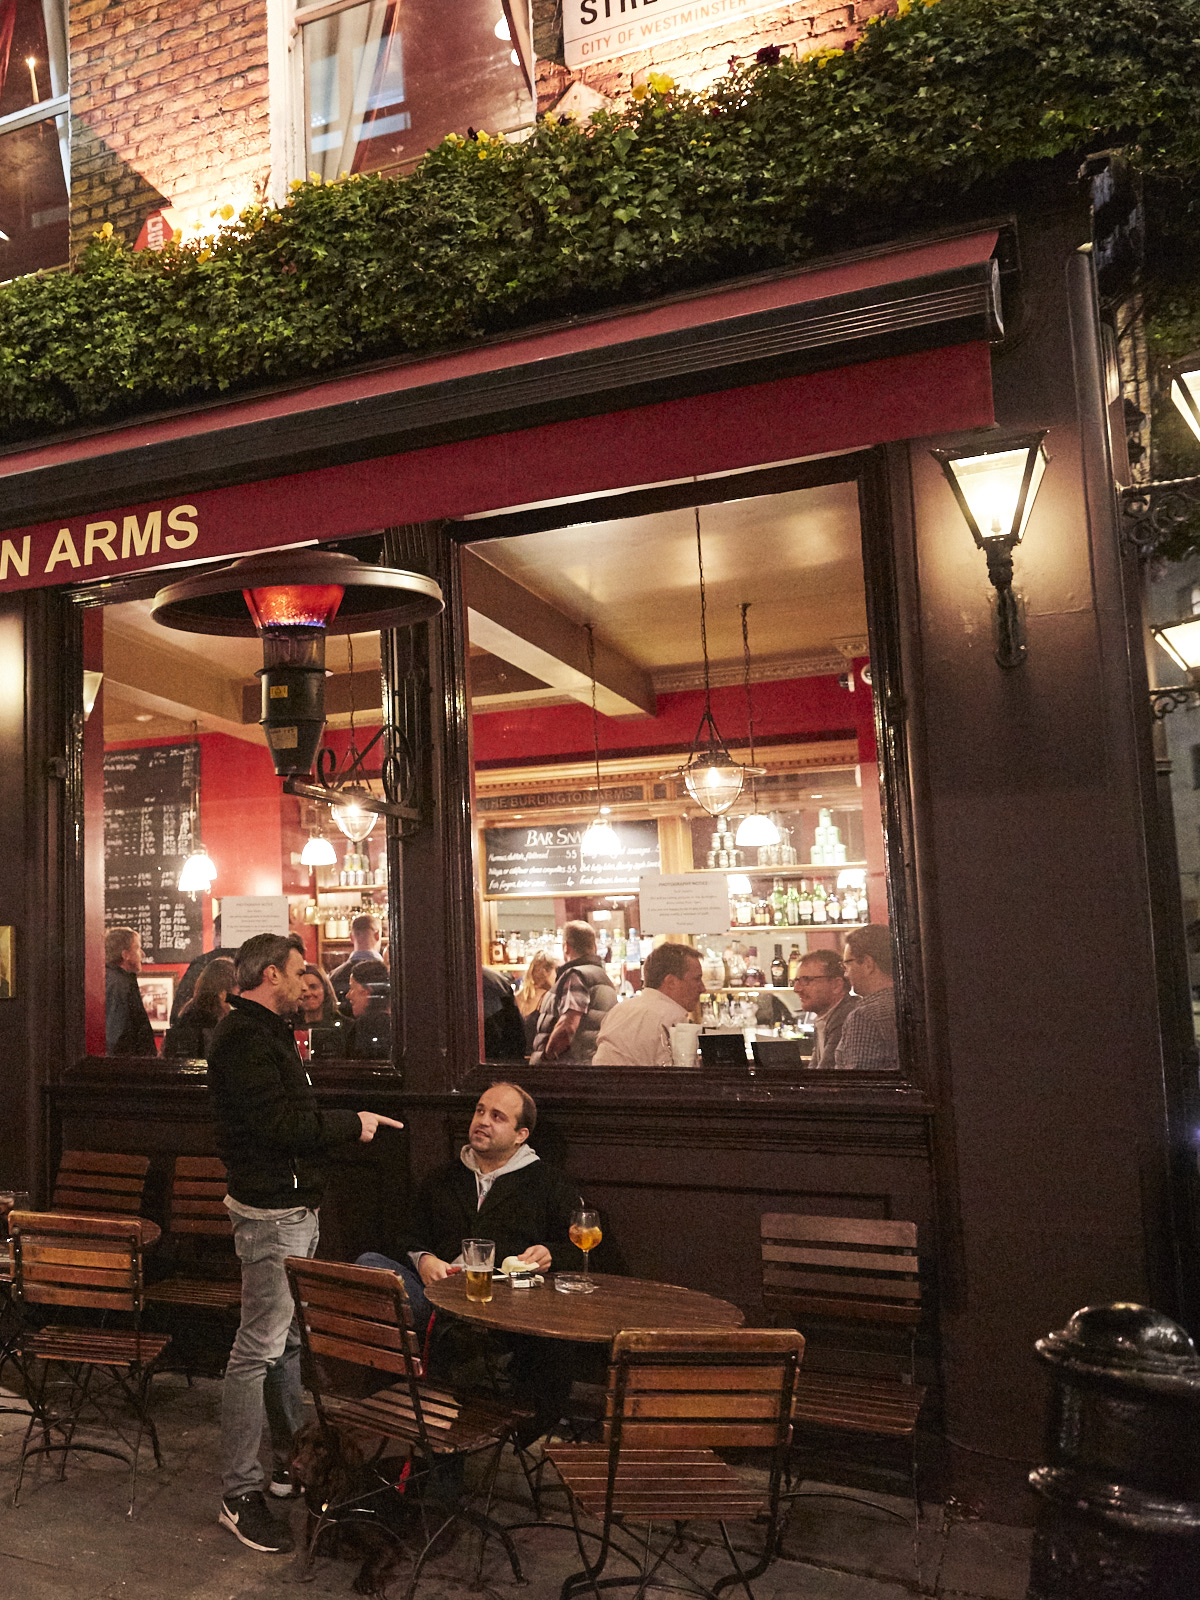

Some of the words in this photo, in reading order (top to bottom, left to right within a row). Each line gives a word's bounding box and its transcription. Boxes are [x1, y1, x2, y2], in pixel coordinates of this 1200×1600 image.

[581, 35, 612, 56] CITY
[618, 28, 635, 45] OF
[640, 0, 747, 37] WESTMINSTER
[44, 504, 200, 573] ARMS
[484, 798, 507, 810] THE
[510, 792, 592, 808] BURLINGTON
[595, 788, 634, 801] ARMS
